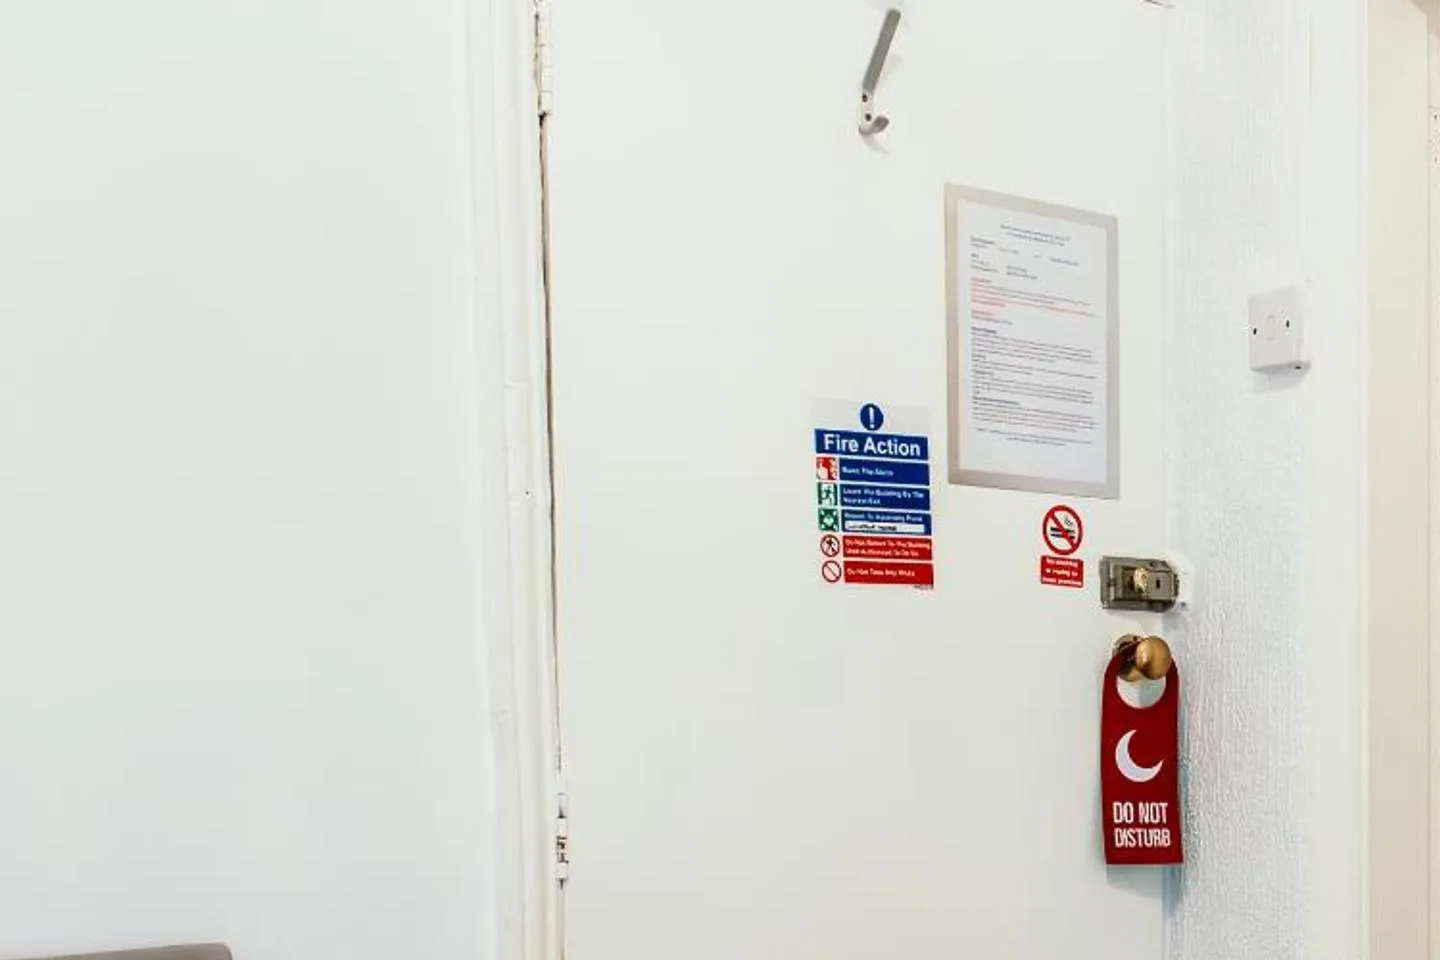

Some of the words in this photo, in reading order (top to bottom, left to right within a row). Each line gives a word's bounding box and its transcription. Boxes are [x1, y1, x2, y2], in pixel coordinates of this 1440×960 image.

[823, 433, 860, 452] Fire
[863, 436, 921, 456] Action
[1113, 801, 1134, 824] DO
[1138, 801, 1168, 825] NOT
[1114, 827, 1171, 848] DISTURB
